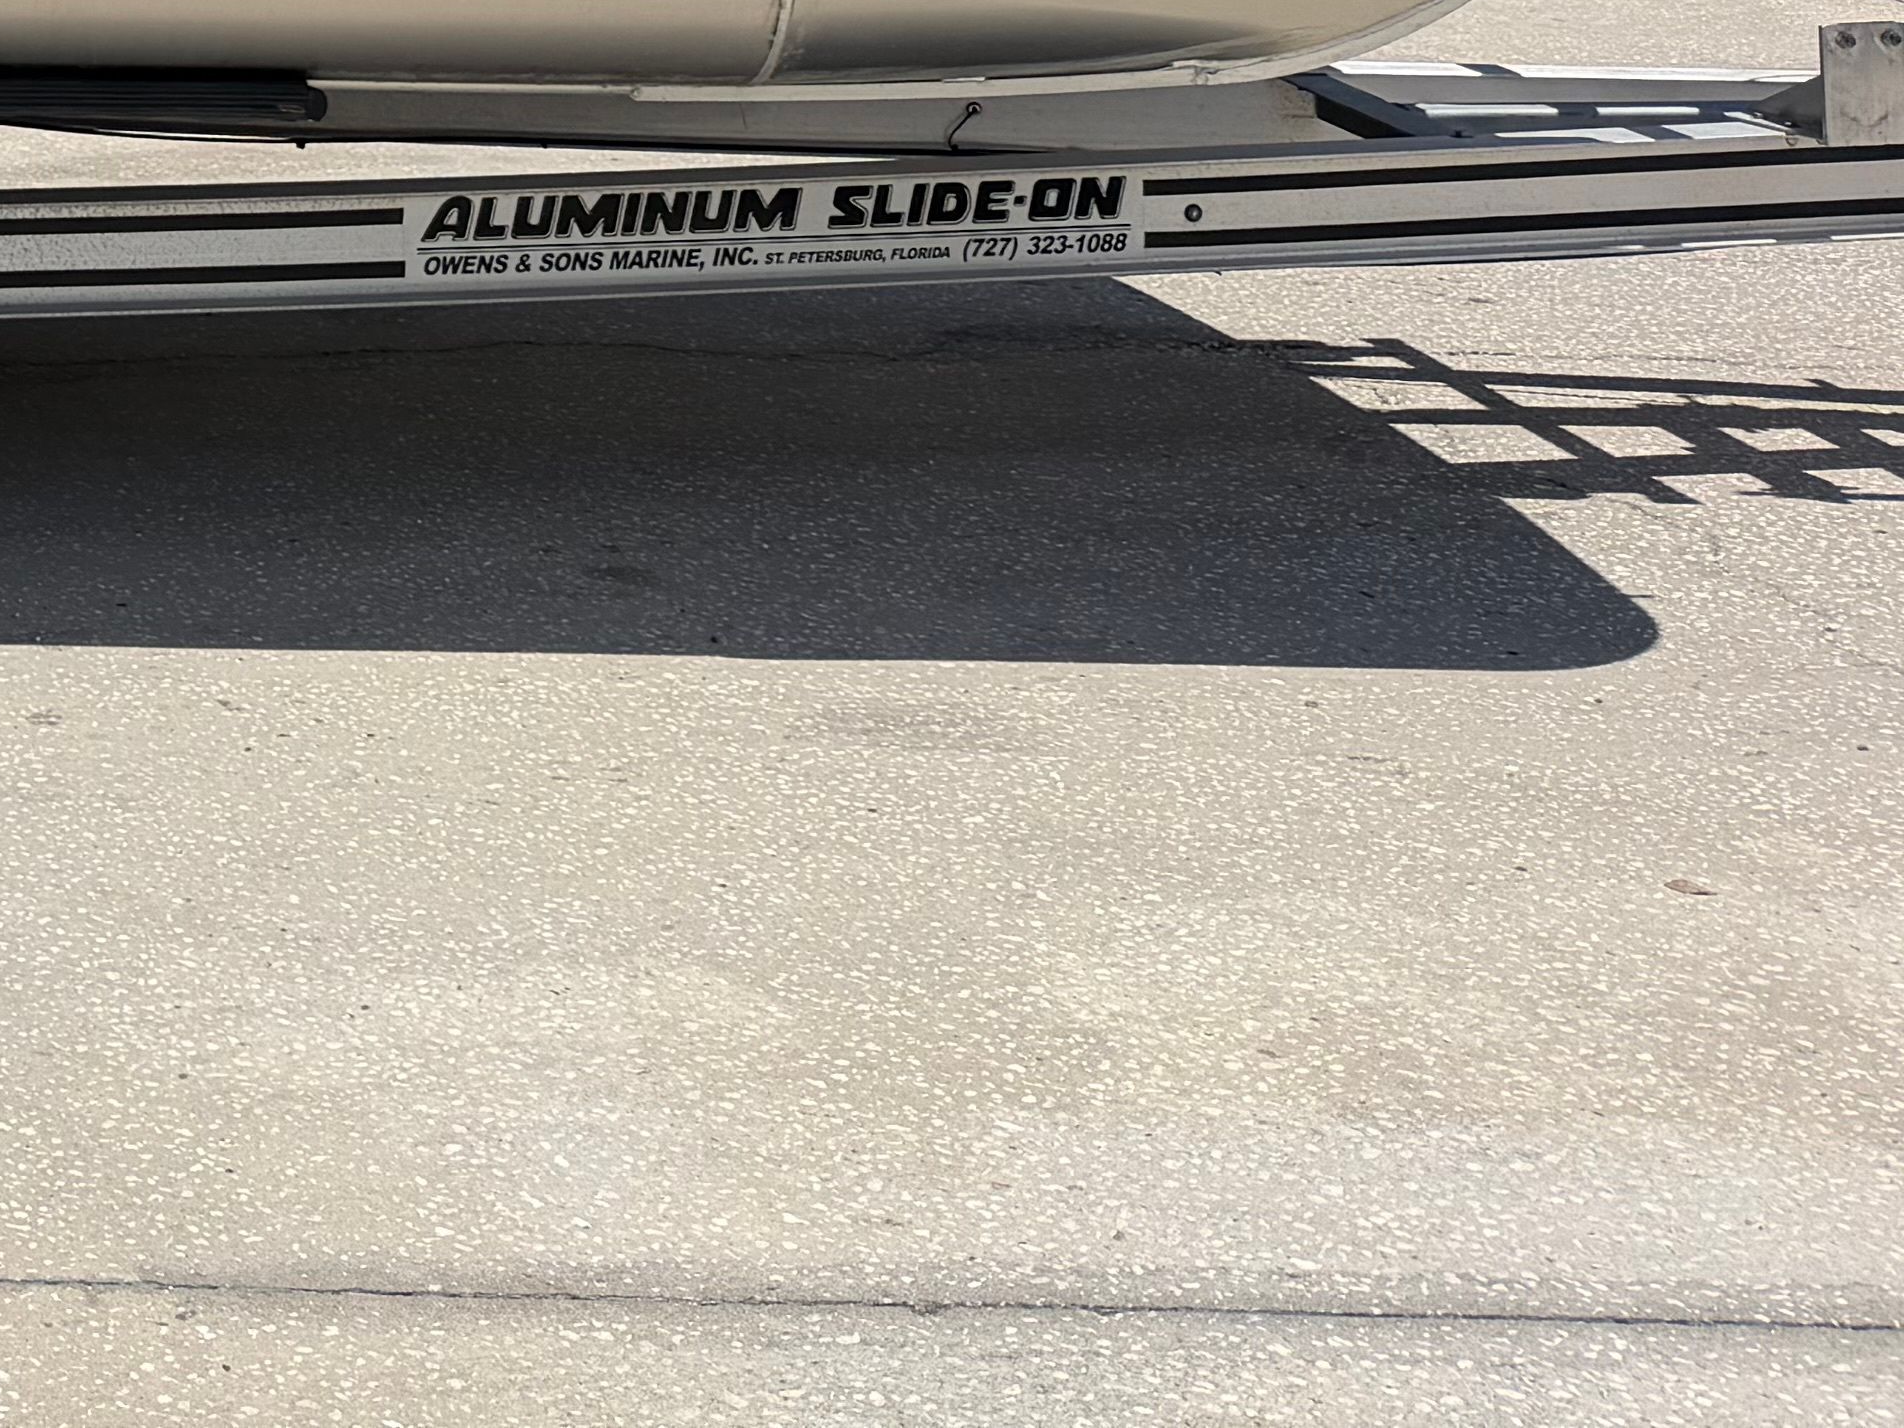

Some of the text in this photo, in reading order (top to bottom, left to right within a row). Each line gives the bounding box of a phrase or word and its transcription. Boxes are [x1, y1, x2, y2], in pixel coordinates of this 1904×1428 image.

[420, 175, 1128, 242] ALUMINUM SLIDE-ON
[423, 232, 1128, 276] OWENS & SONS MARINE, INC. ST. PETERSBURG, FLORIDA (727) 323-1088
